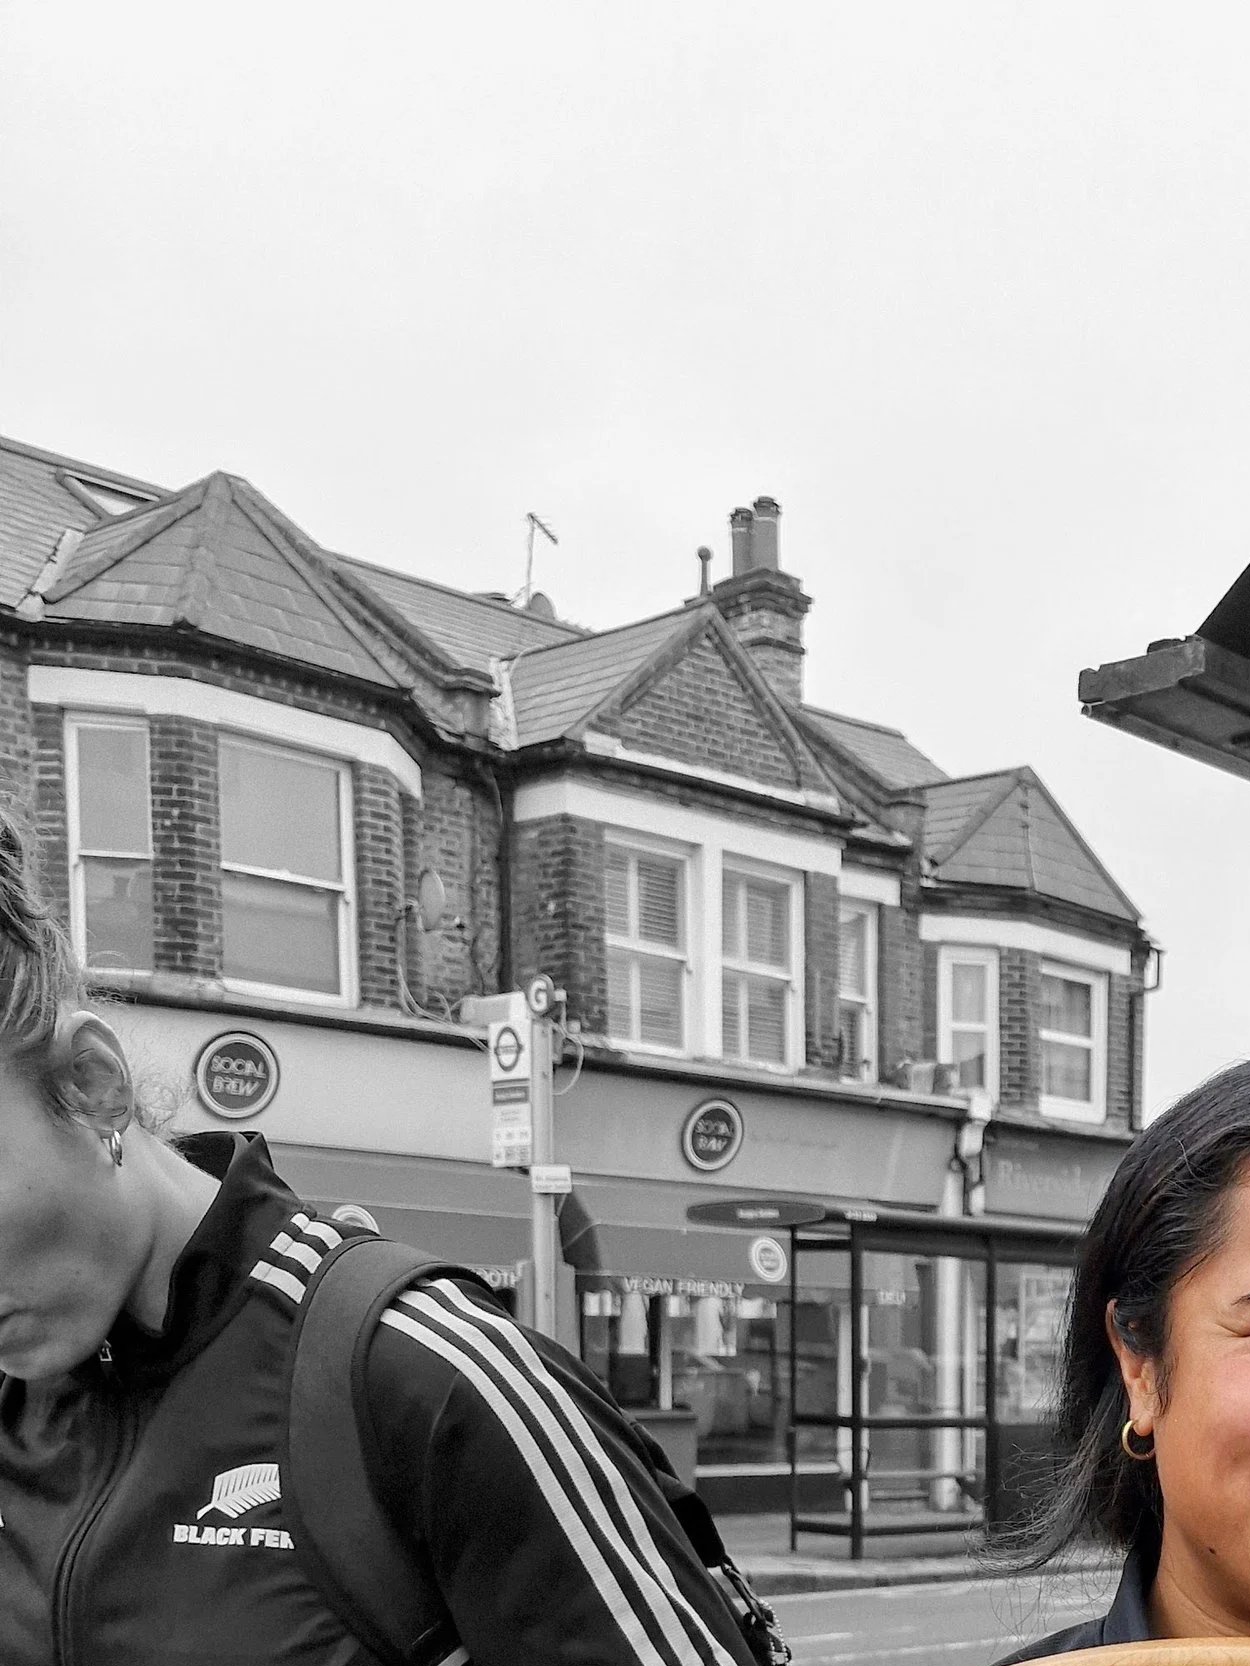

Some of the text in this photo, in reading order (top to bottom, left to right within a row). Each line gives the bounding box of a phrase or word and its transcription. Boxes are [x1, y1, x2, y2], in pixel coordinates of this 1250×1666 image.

[529, 979, 548, 1012] G
[624, 1278, 745, 1298] VEGAN FRIENDLY
[173, 1524, 247, 1546] BLACK
